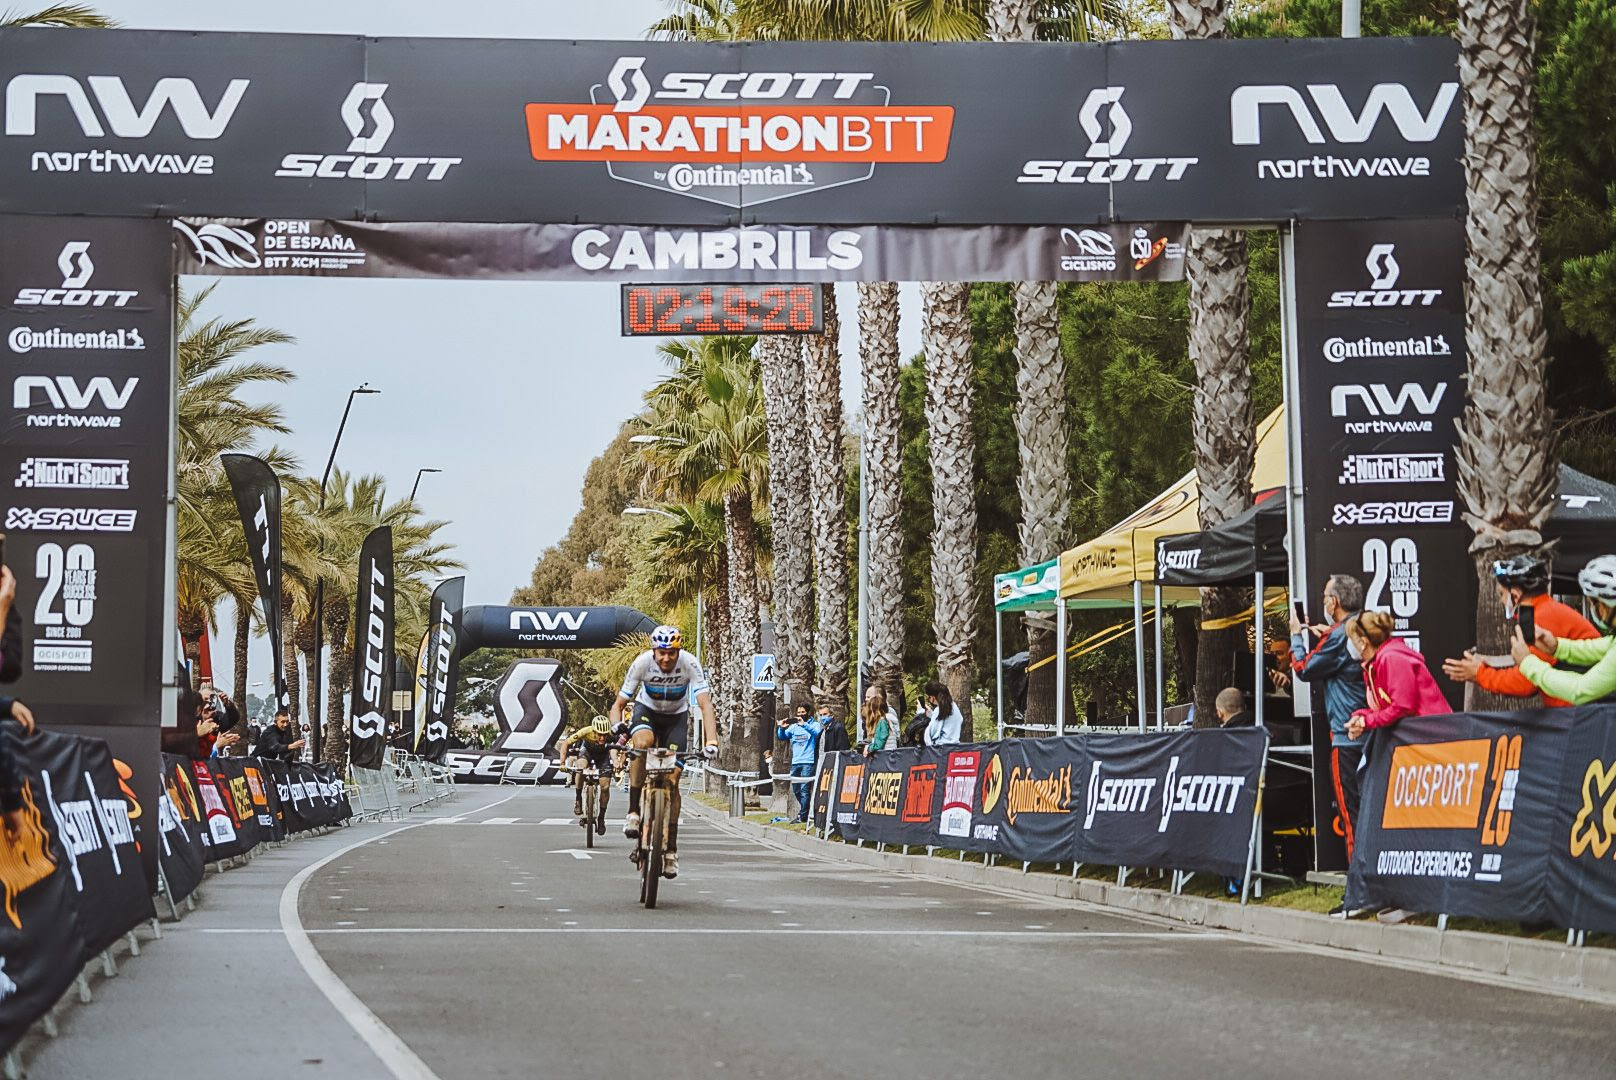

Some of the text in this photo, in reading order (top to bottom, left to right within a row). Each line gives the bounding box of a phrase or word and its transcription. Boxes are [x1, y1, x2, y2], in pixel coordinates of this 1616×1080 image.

[654, 72, 875, 100] SCOTT
[31, 149, 214, 175] northwave
[274, 153, 463, 181] SCOTT
[1016, 157, 1199, 184] SCOTT
[1258, 154, 1430, 179] northwave
[667, 163, 792, 191] Continental
[264, 220, 310, 234] OPEN
[264, 234, 356, 250] DE ESPAÑA
[571, 231, 863, 272] CAMBRILS
[264, 257, 320, 269] BTT XCM
[1061, 260, 1117, 271] CICLISMO
[13, 288, 139, 307] SCOTT
[1327, 289, 1442, 307] SCOTT
[8, 326, 126, 353] Continental
[1323, 336, 1433, 362] Continental
[27, 413, 121, 428] northwave
[1345, 420, 1433, 434] northwave
[34, 460, 130, 487] NutriSport
[1356, 457, 1445, 482] NutriSport
[6, 508, 136, 531] X-SAUCE
[1333, 501, 1453, 525] X-SAUCE
[1165, 549, 1202, 569] SCOTT
[34, 542, 95, 626] 20
[363, 557, 386, 708] SCOTT
[518, 633, 578, 641] northwave
[39, 650, 87, 659] OCISPORT
[433, 602, 454, 718] SCOTT
[446, 752, 569, 780] SCO
[1007, 766, 1065, 826] Continental
[1096, 778, 1157, 812] SCOTT
[1172, 775, 1246, 814] SCOTT
[1393, 762, 1480, 808] OCISPORT
[1377, 850, 1414, 876] OUTDOOR
[1414, 850, 1472, 878] EXPERIENCES
